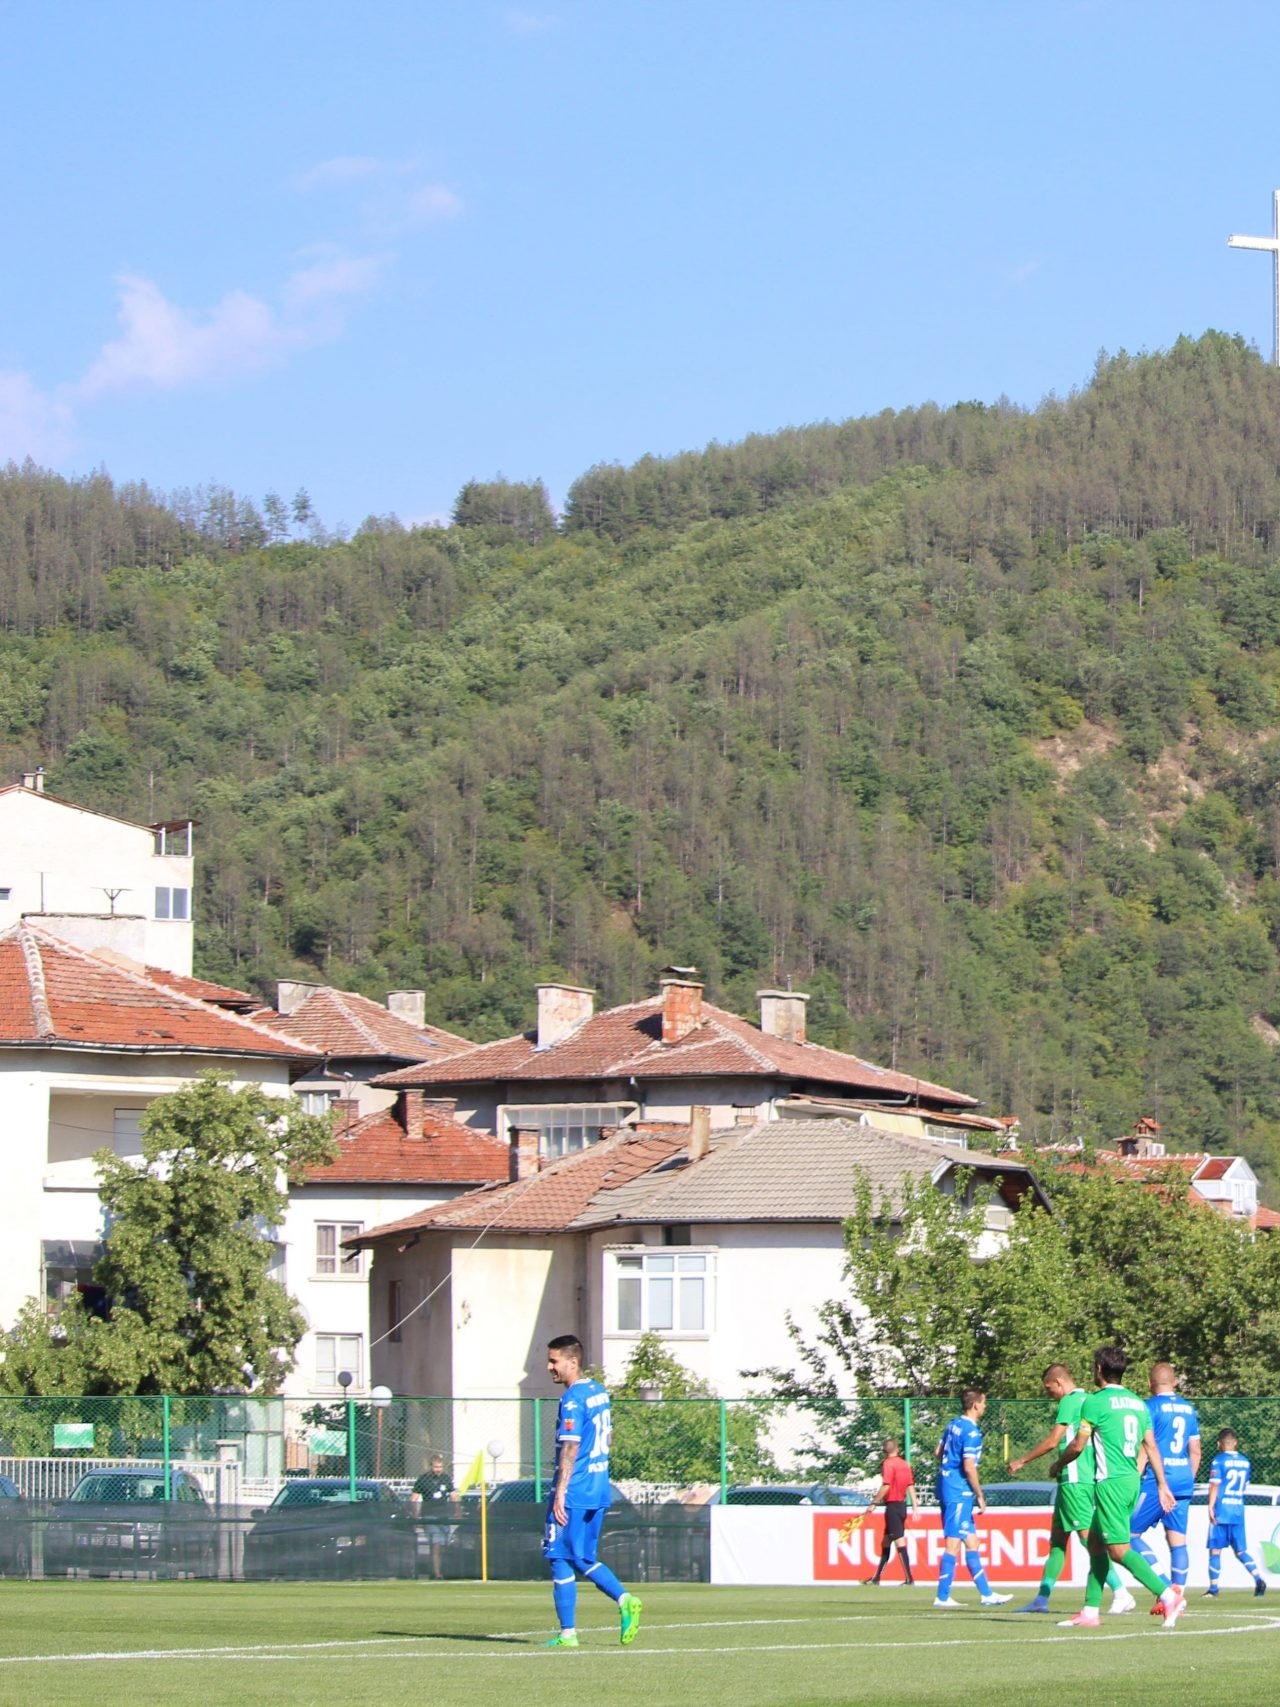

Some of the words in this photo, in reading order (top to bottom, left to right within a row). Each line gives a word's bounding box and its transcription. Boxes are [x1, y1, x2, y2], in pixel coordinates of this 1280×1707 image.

[1123, 1415, 1138, 1457] 9
[1170, 1416, 1186, 1453] 3
[1224, 1469, 1246, 1496] 21
[828, 1528, 1054, 1566] NUTREND
